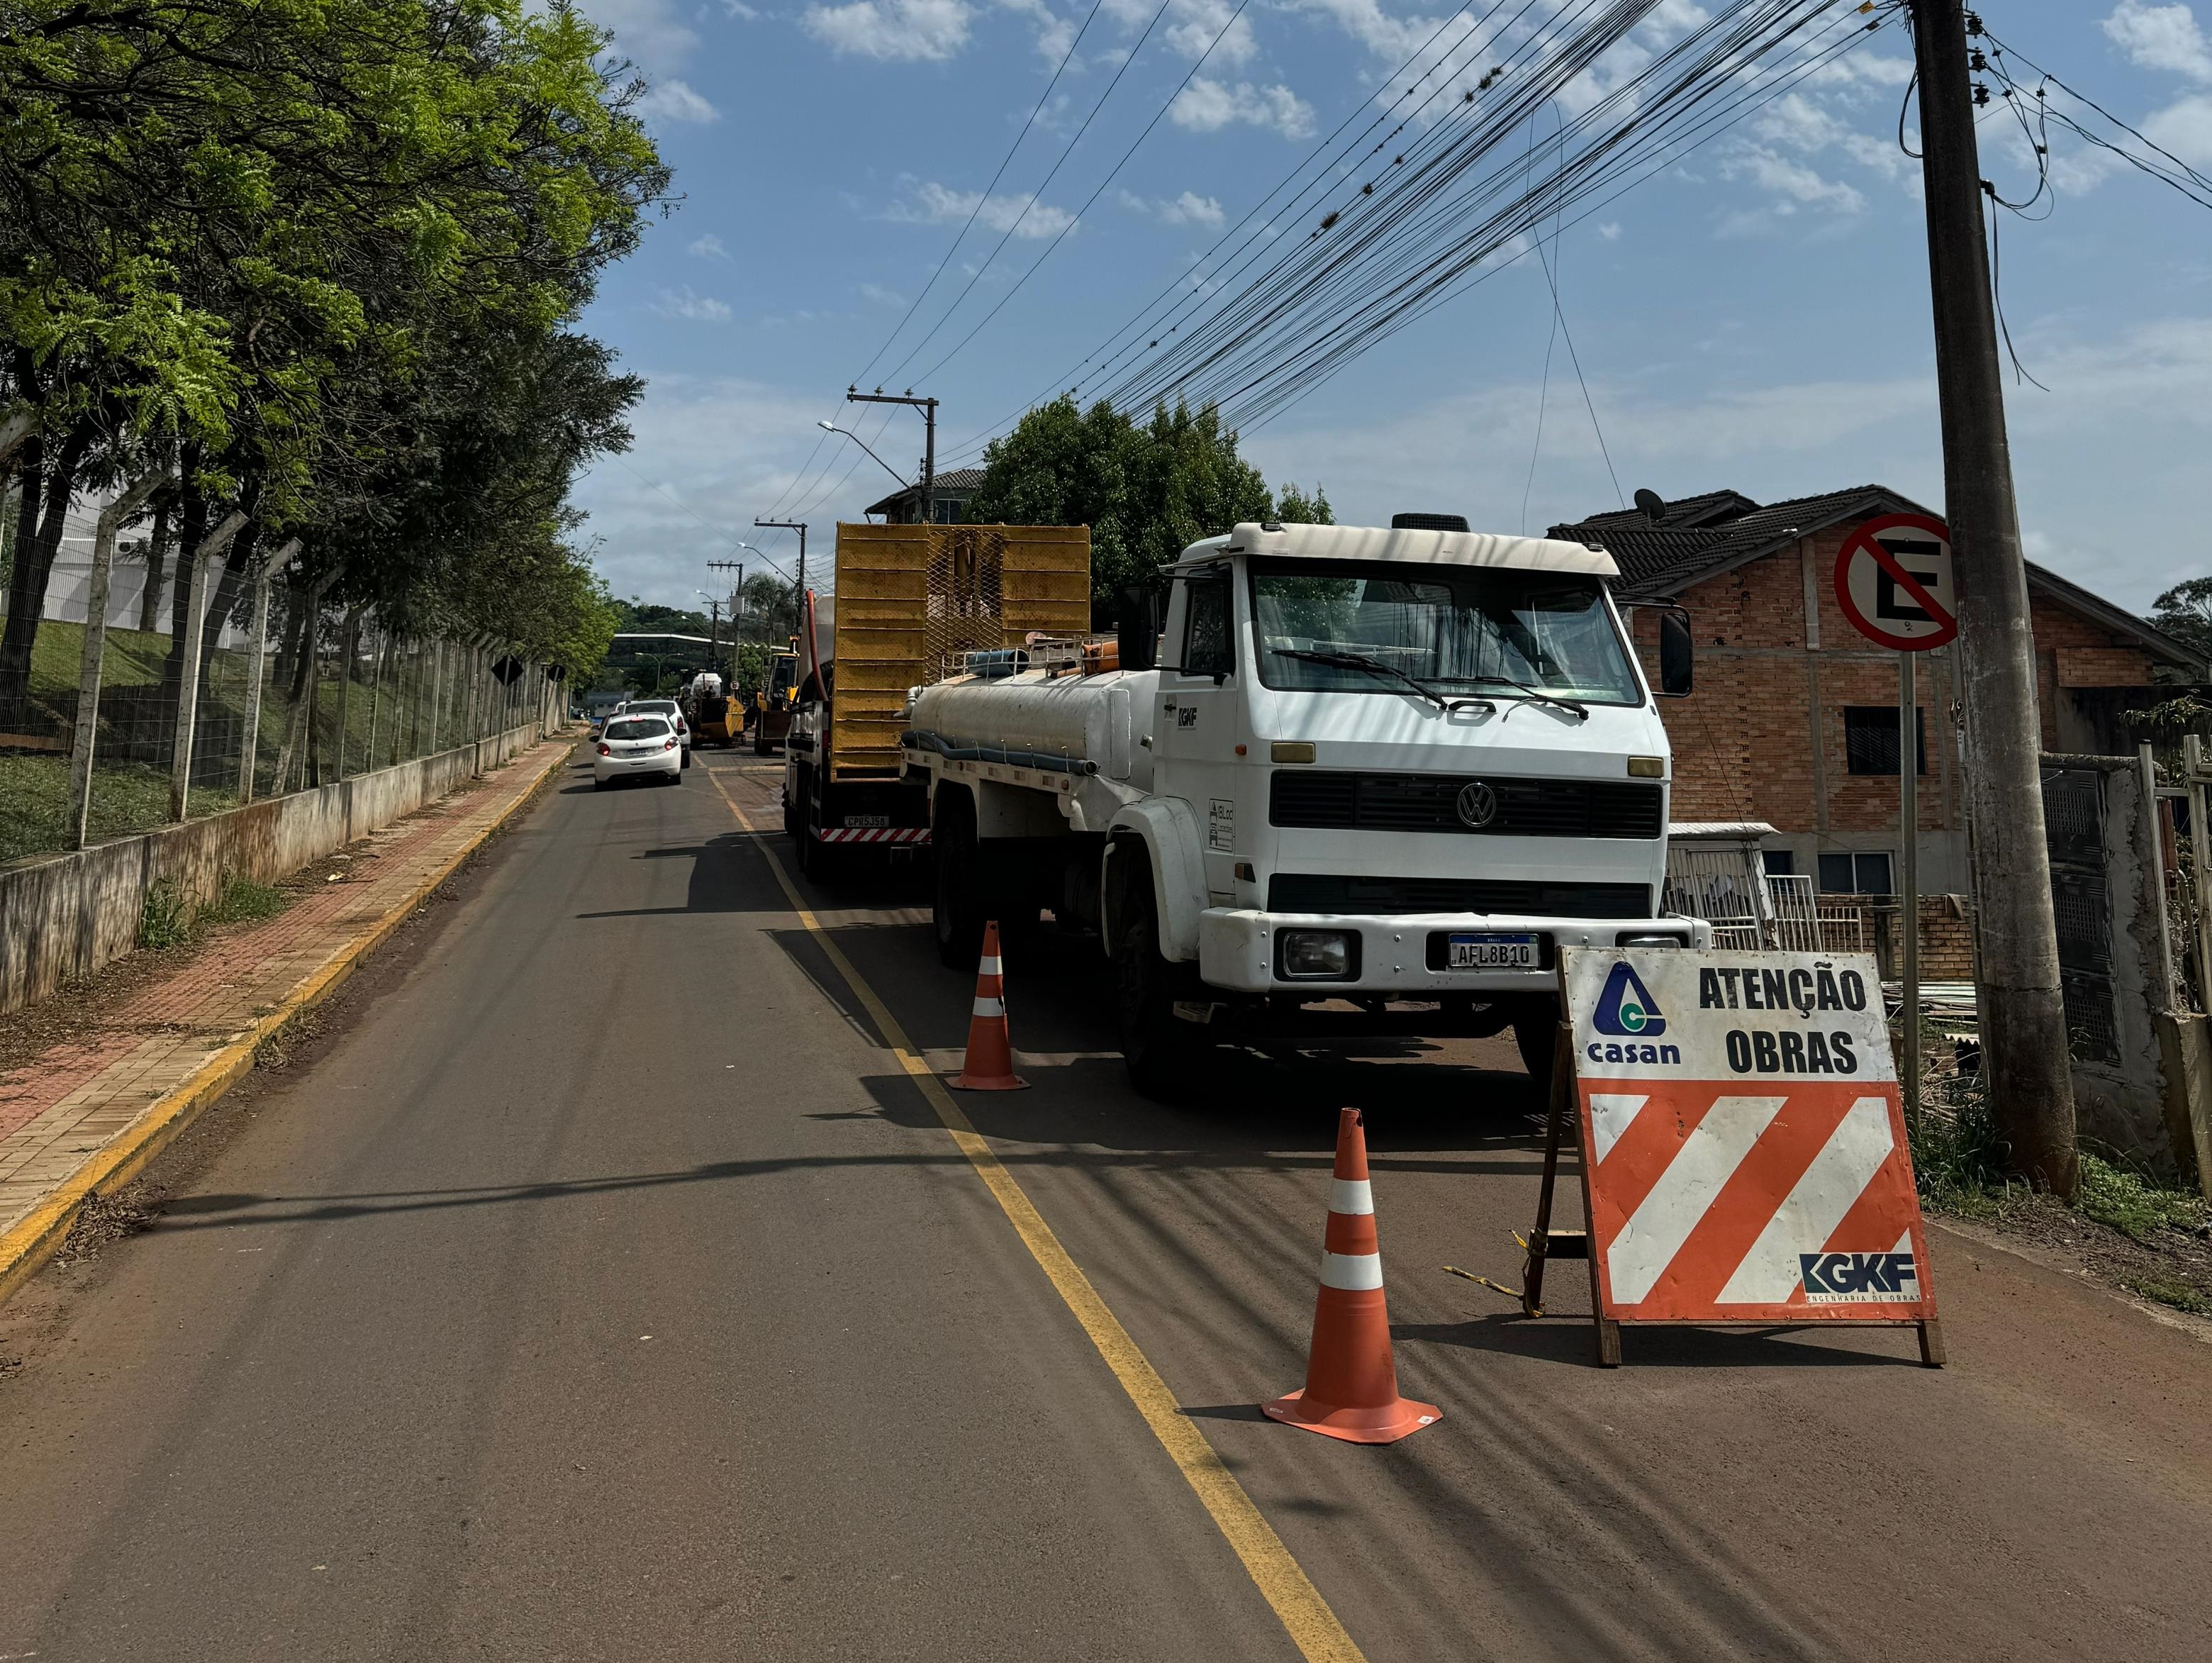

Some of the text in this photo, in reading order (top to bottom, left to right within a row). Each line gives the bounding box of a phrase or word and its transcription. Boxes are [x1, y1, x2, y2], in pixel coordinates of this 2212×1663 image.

[1458, 945, 1529, 963] AFL8B10
[1699, 962, 1867, 1019] ATENÇÃO
[1587, 1043, 1681, 1064] casan
[1726, 1030, 1858, 1074] OBRAS
